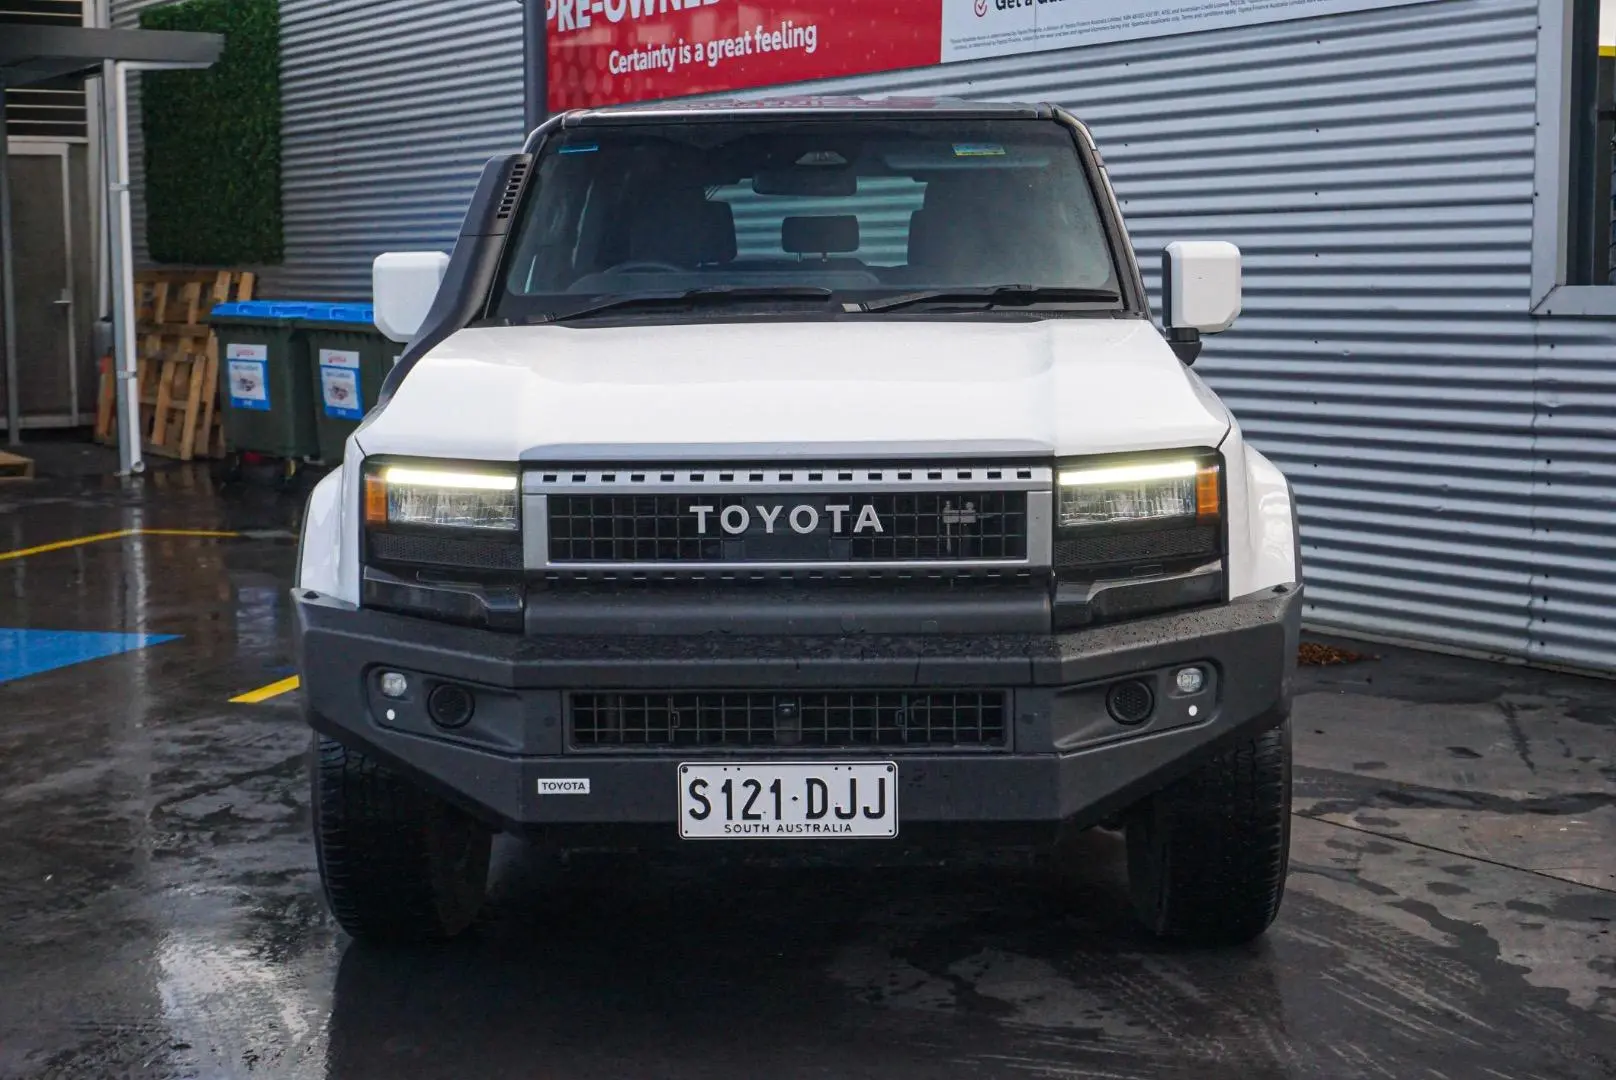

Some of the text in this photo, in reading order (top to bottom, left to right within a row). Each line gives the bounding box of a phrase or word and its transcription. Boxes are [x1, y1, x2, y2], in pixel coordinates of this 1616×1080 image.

[547, 0, 720, 32] RE-OW
[609, 20, 817, 74] Certainty is a great feeling
[689, 504, 884, 534] TOYOTA
[541, 781, 586, 791] TOYOTA
[724, 823, 853, 834] SOUTH AUSTRALIA
